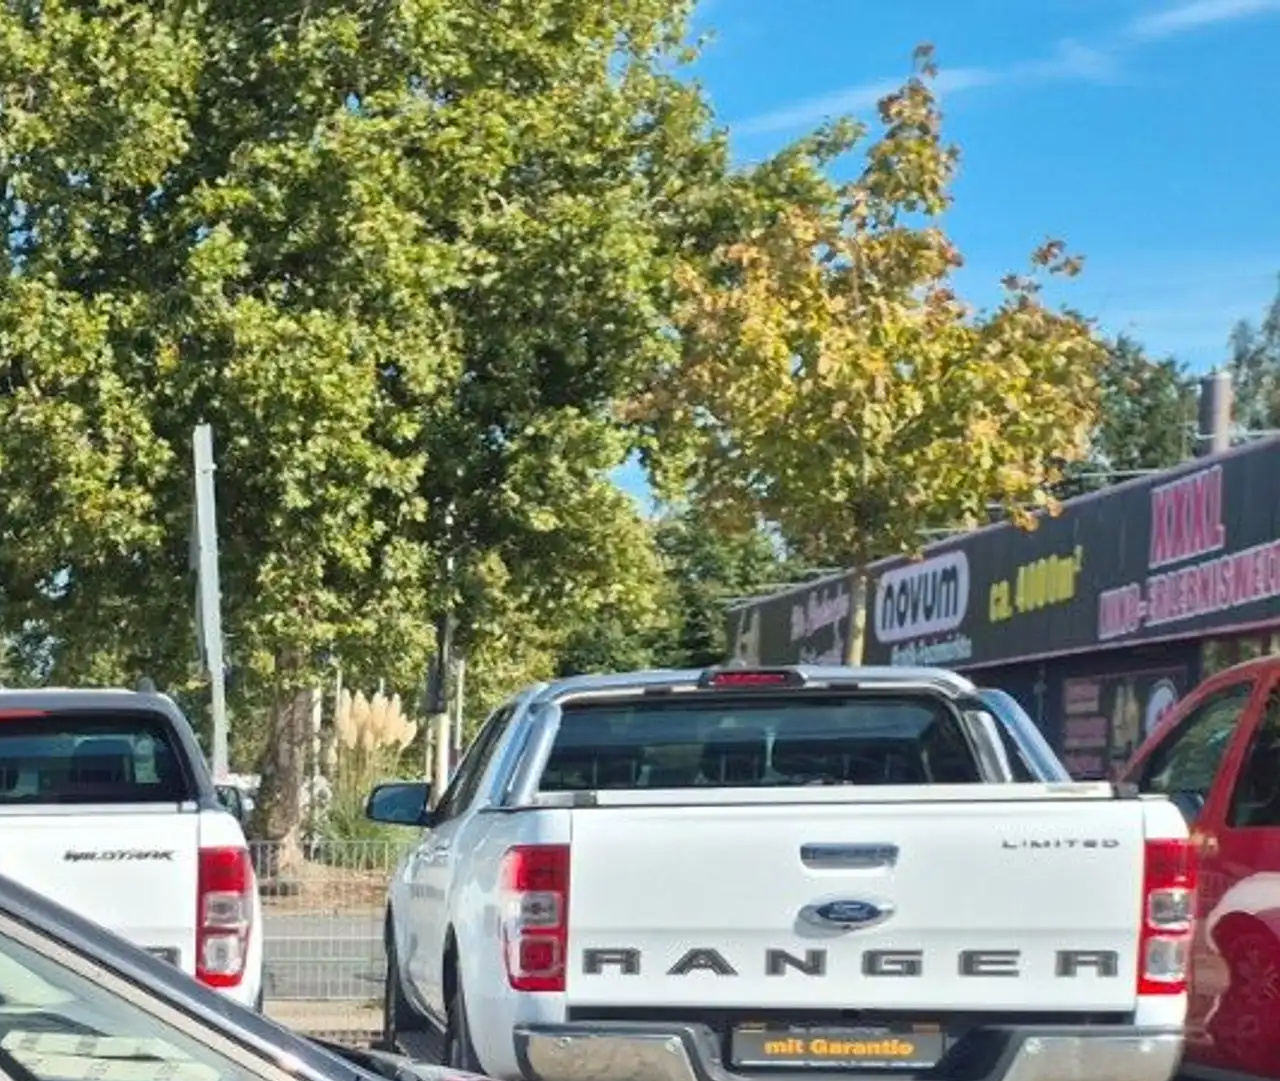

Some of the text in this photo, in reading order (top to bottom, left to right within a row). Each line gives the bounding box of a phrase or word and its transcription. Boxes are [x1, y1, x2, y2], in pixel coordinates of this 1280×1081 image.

[1148, 464, 1225, 569] XXXL
[881, 563, 959, 630] novum
[1001, 837, 1120, 850] LIMITED
[581, 948, 1119, 976] RANGER
[765, 1037, 915, 1056] mit Garantie
